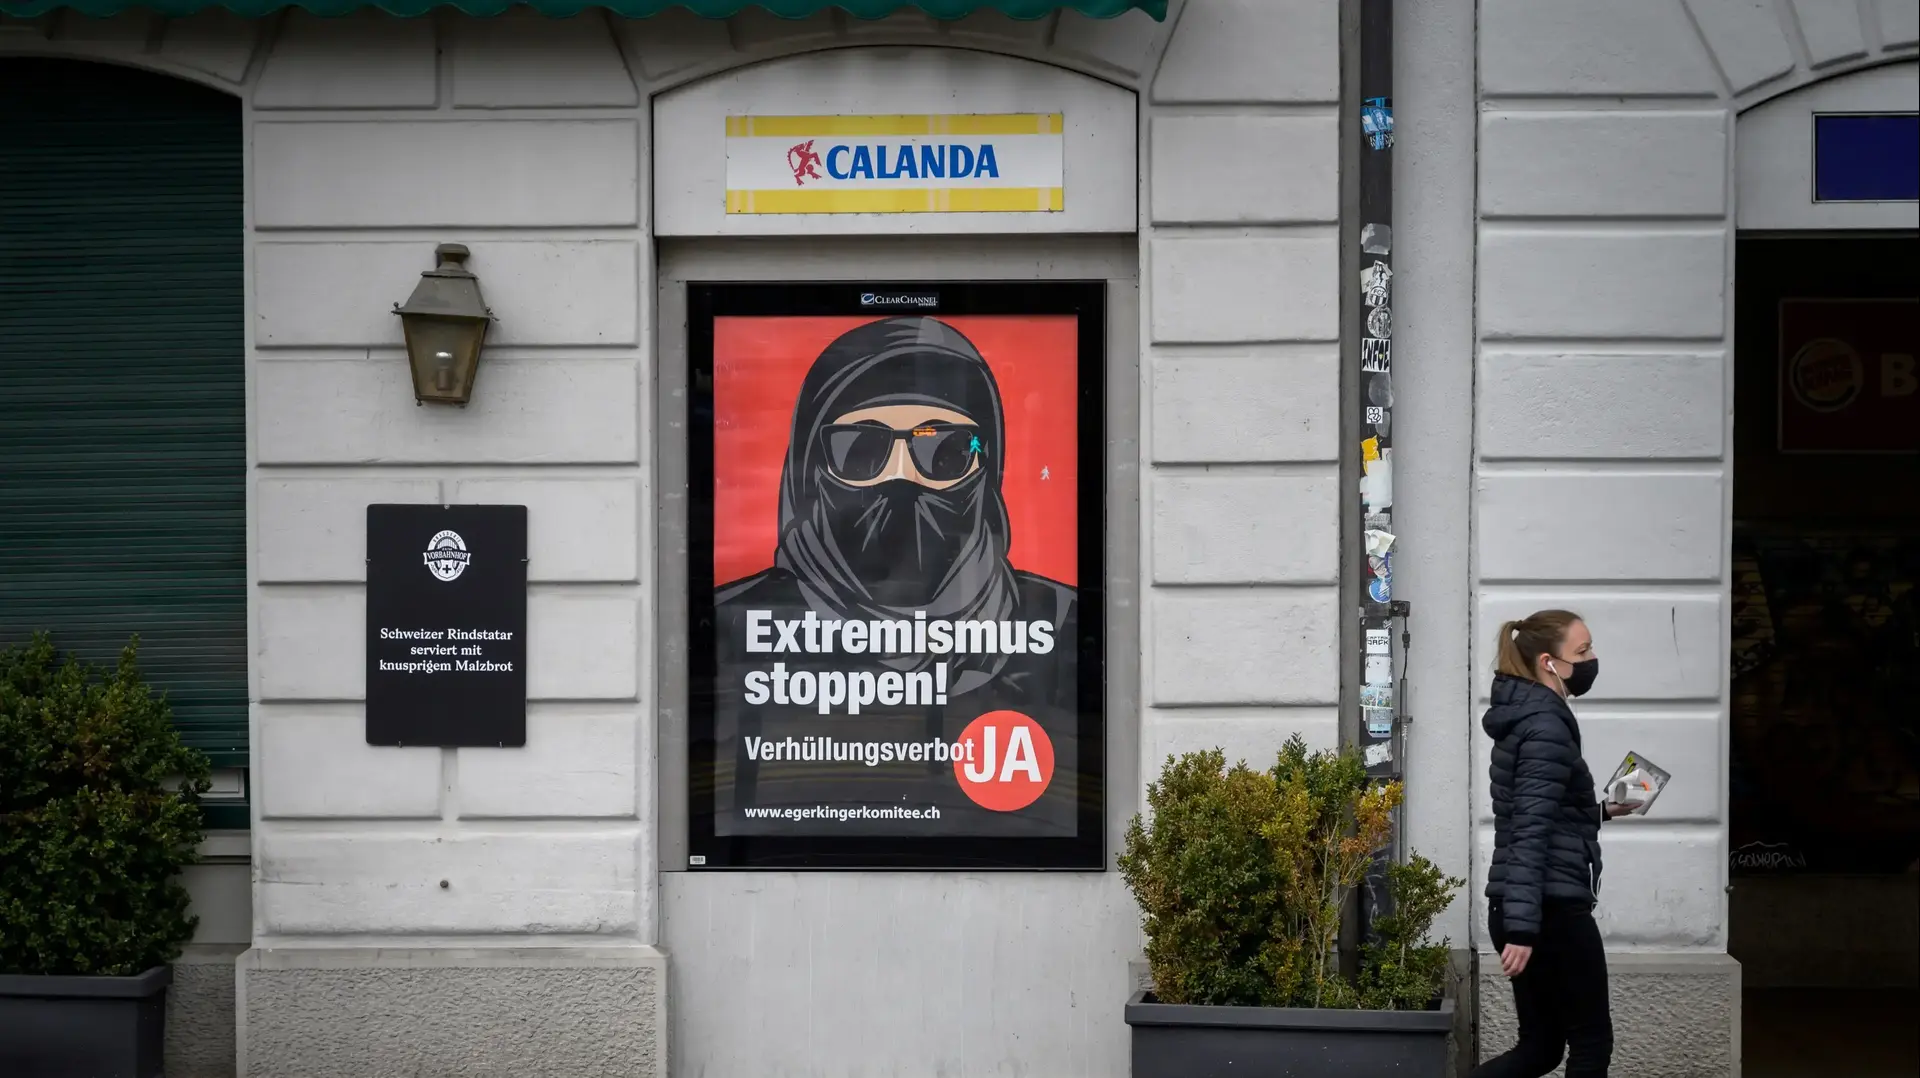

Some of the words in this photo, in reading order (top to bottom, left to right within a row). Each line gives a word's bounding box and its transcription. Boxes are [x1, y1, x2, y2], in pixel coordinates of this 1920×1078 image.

[826, 144, 999, 180] CALANDA
[426, 550, 468, 561] VORBAHNHOF
[380, 627, 444, 640] Schweizer
[447, 628, 513, 640] Rindstatar
[746, 609, 1055, 655] Extremismus
[410, 644, 457, 655] serviert
[460, 644, 482, 655] mit
[379, 659, 451, 673] knusprigem
[455, 659, 513, 672] Malzbrot
[744, 662, 947, 715] stoppen!
[744, 736, 975, 767] Verhüllungsverbot
[964, 726, 1042, 783] JA
[744, 805, 941, 822] www.egerkingerkomitee.ch
